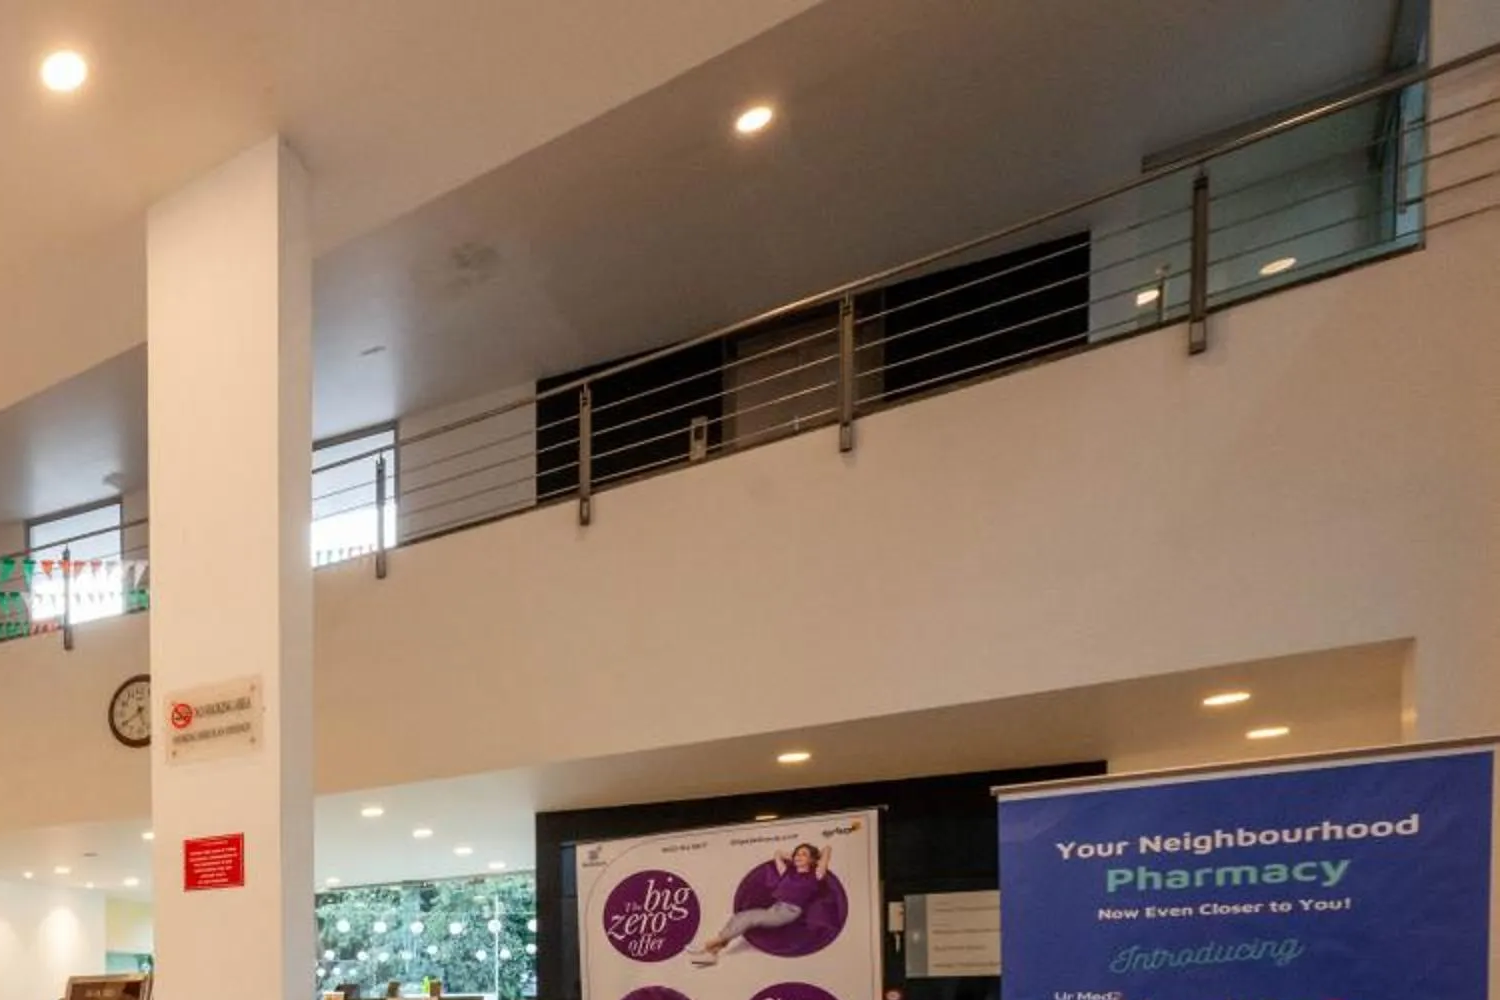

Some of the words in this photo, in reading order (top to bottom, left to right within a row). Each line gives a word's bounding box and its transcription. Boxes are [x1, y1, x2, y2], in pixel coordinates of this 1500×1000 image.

[1055, 838, 1129, 861] Your
[1139, 814, 1421, 856] Neighbourhood
[1105, 858, 1351, 893] Pharmacy
[644, 876, 692, 920] big
[1098, 906, 1139, 920] Now
[1145, 904, 1194, 918] Even
[1200, 901, 1262, 917] Closer
[1269, 900, 1293, 914] to
[1299, 897, 1352, 912] You!
[607, 911, 668, 940] zero
[627, 933, 665, 957] offer
[1109, 937, 1306, 975] Introducing
